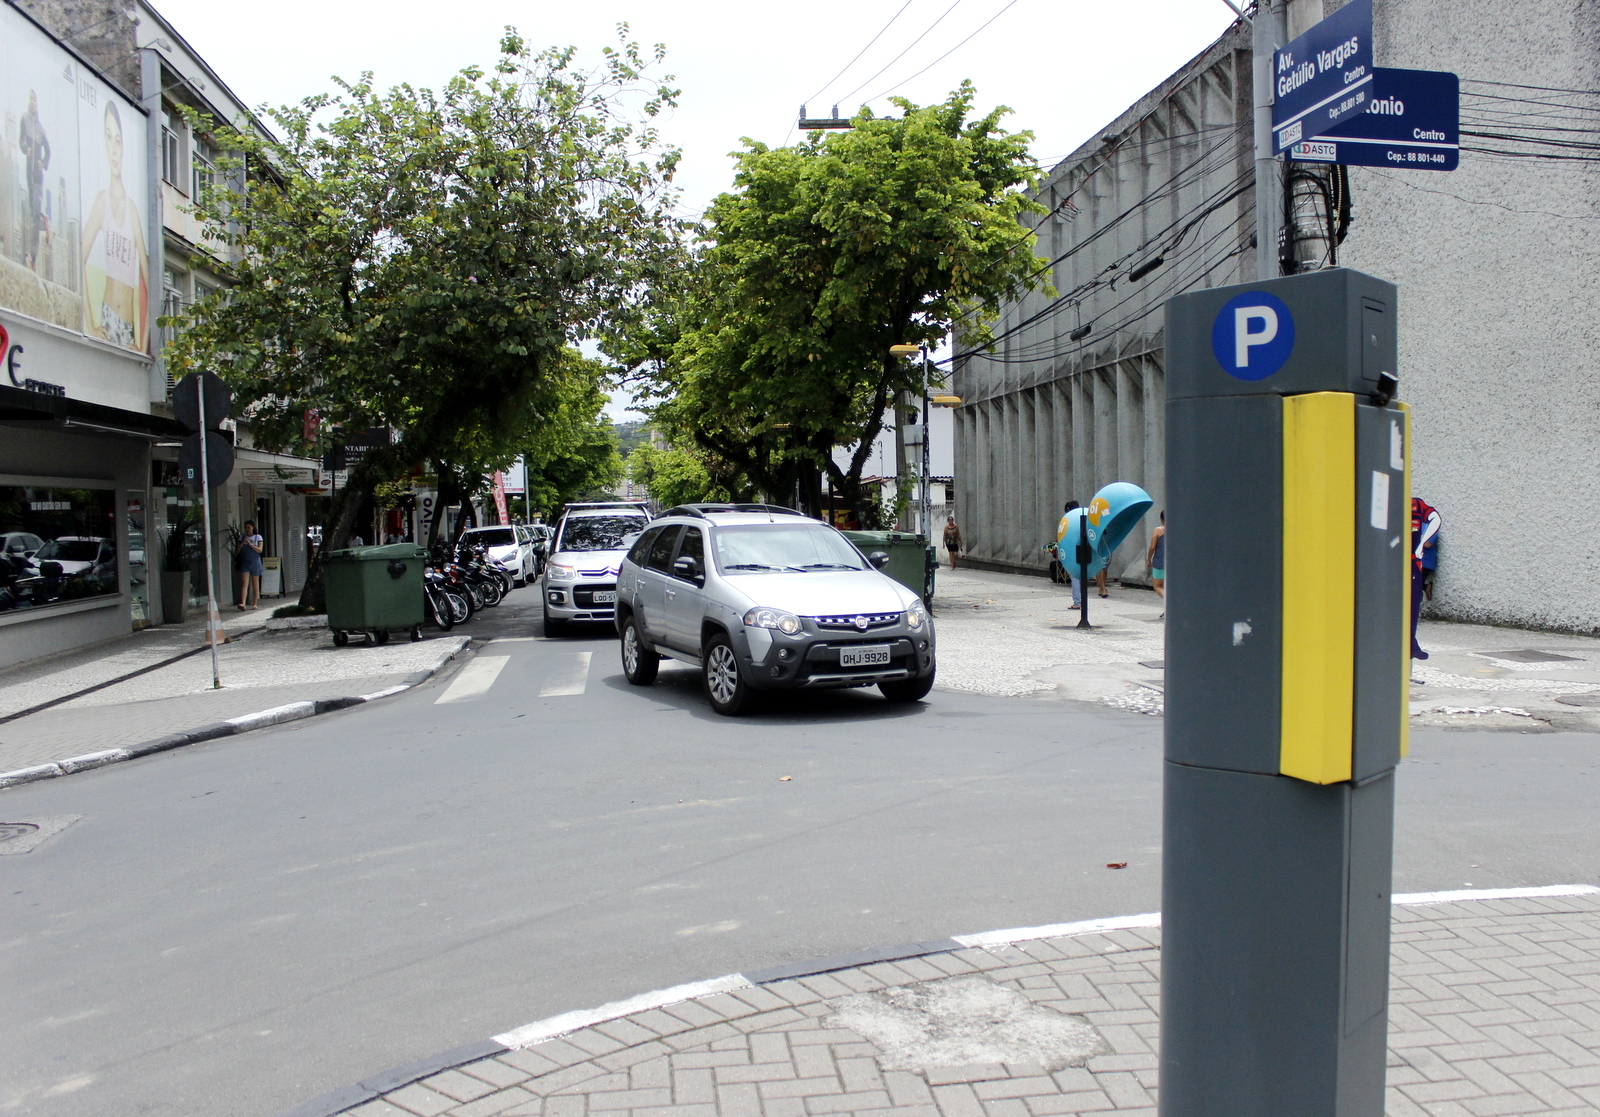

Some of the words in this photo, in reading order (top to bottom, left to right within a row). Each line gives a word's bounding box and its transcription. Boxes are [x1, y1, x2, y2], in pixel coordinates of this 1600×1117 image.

[1278, 53, 1294, 74] Av.
[1278, 61, 1315, 97] Getúlio
[1317, 36, 1358, 73] Vargas
[1344, 65, 1365, 84] Centro
[1366, 96, 1404, 116] onio
[1413, 128, 1445, 141] Centro
[1311, 145, 1335, 155] ASTC
[1387, 151, 1406, 163] Cep.:
[1407, 152, 1416, 162] 88
[1417, 153, 1445, 163] 801-440
[1235, 305, 1278, 368] P
[1090, 502, 1099, 514] oi
[842, 652, 888, 665] QHJ-9928
